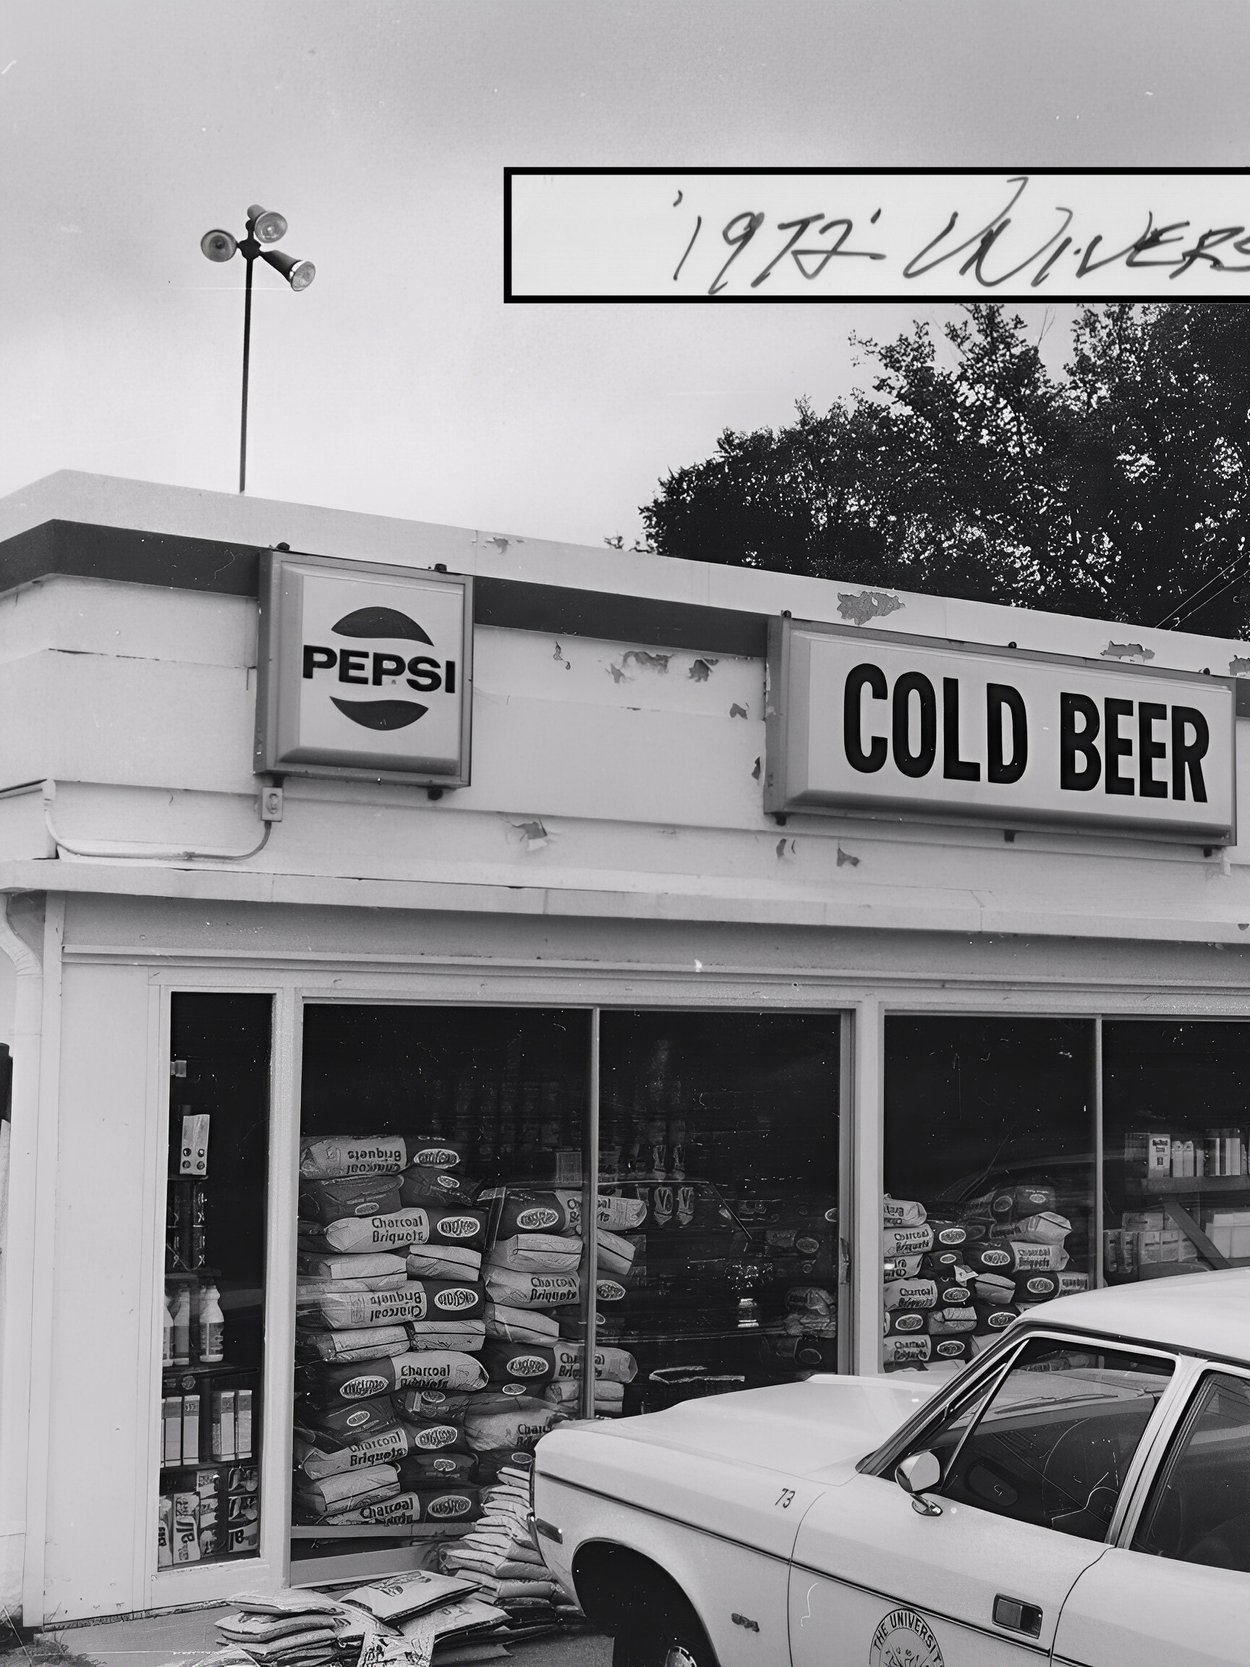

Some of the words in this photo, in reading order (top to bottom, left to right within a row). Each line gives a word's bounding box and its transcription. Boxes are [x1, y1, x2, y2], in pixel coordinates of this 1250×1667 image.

[303, 644, 456, 694] PEPSI
[843, 662, 1028, 785] COLD
[1060, 691, 1210, 803] BEER
[372, 1215, 423, 1228] Charcoal
[370, 1305, 422, 1322] Charcoal
[401, 1364, 450, 1377] Charcoal
[359, 1497, 414, 1519] Charcoal
[775, 1487, 796, 1509] 73
[873, 1622, 889, 1651] THE
[890, 1611, 944, 1667] UNIVERSIT
